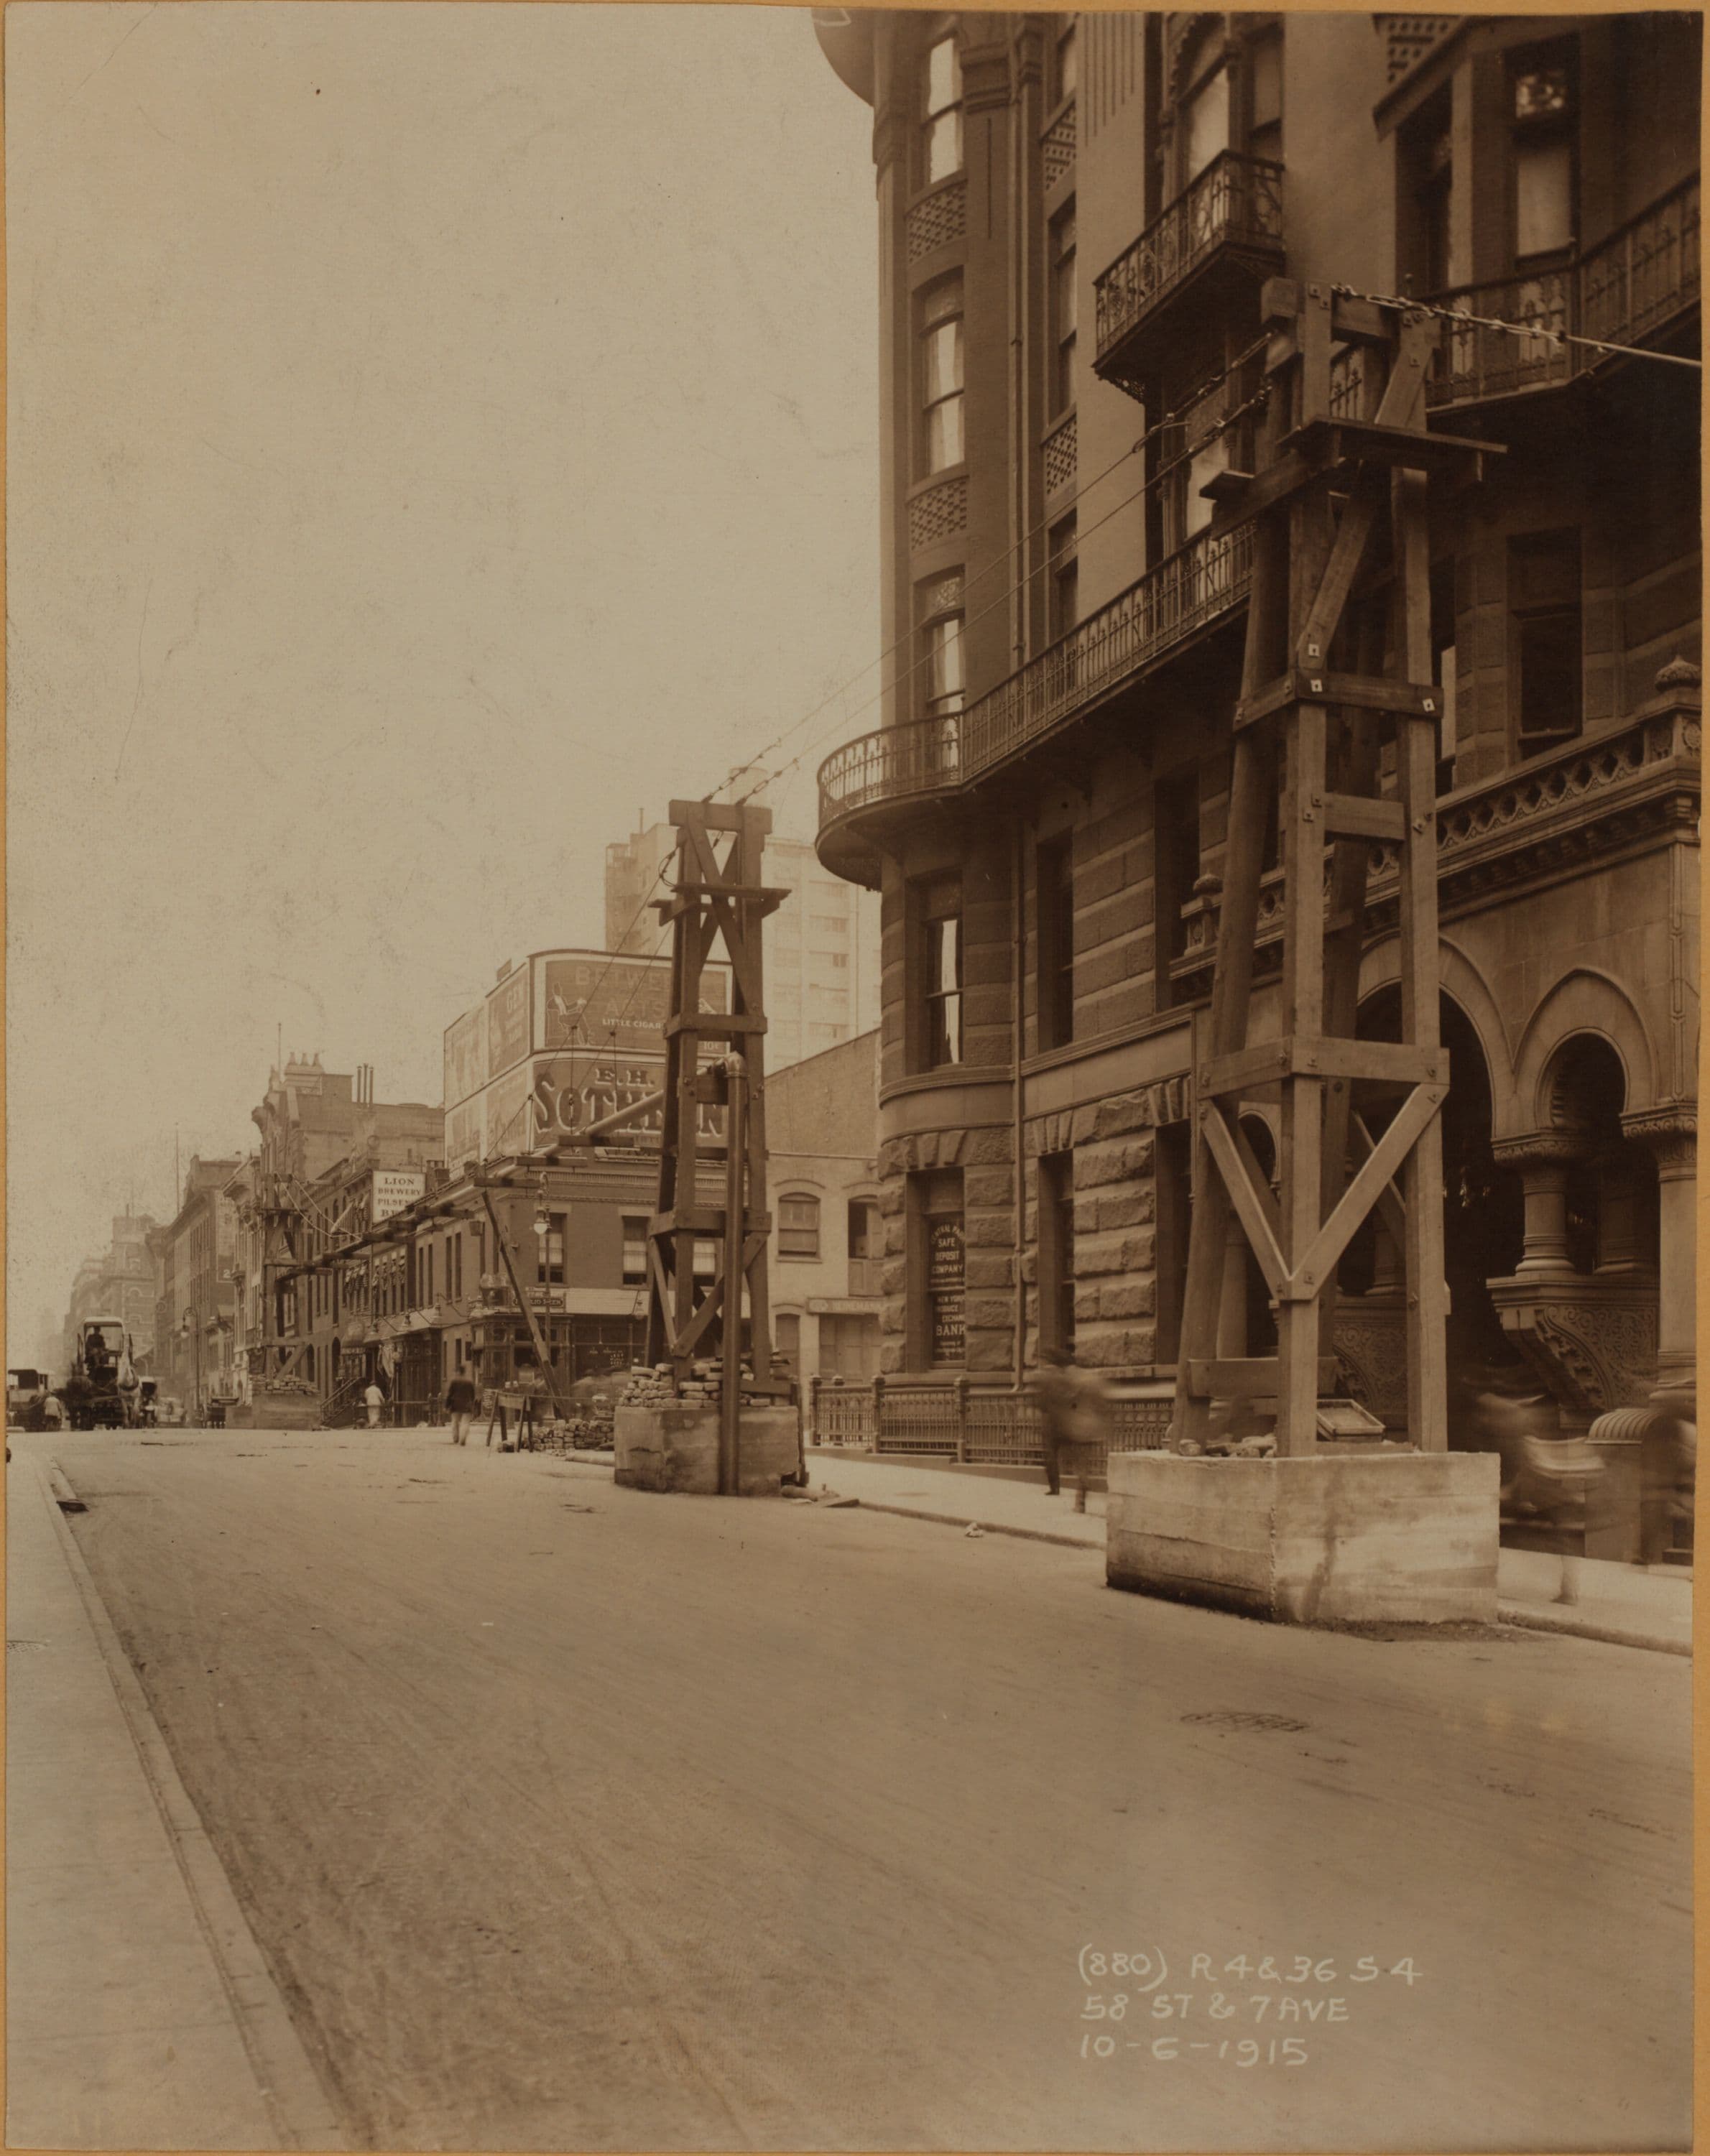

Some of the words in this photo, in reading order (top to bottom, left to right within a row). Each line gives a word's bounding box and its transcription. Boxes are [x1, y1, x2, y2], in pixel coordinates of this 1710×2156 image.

[602, 1018, 632, 1028] LITTLE
[633, 1020, 664, 1030] CIGAR
[378, 1187, 421, 1195] BREWERY
[938, 1237, 956, 1248] SAFE
[936, 1324, 966, 1336] BANK
